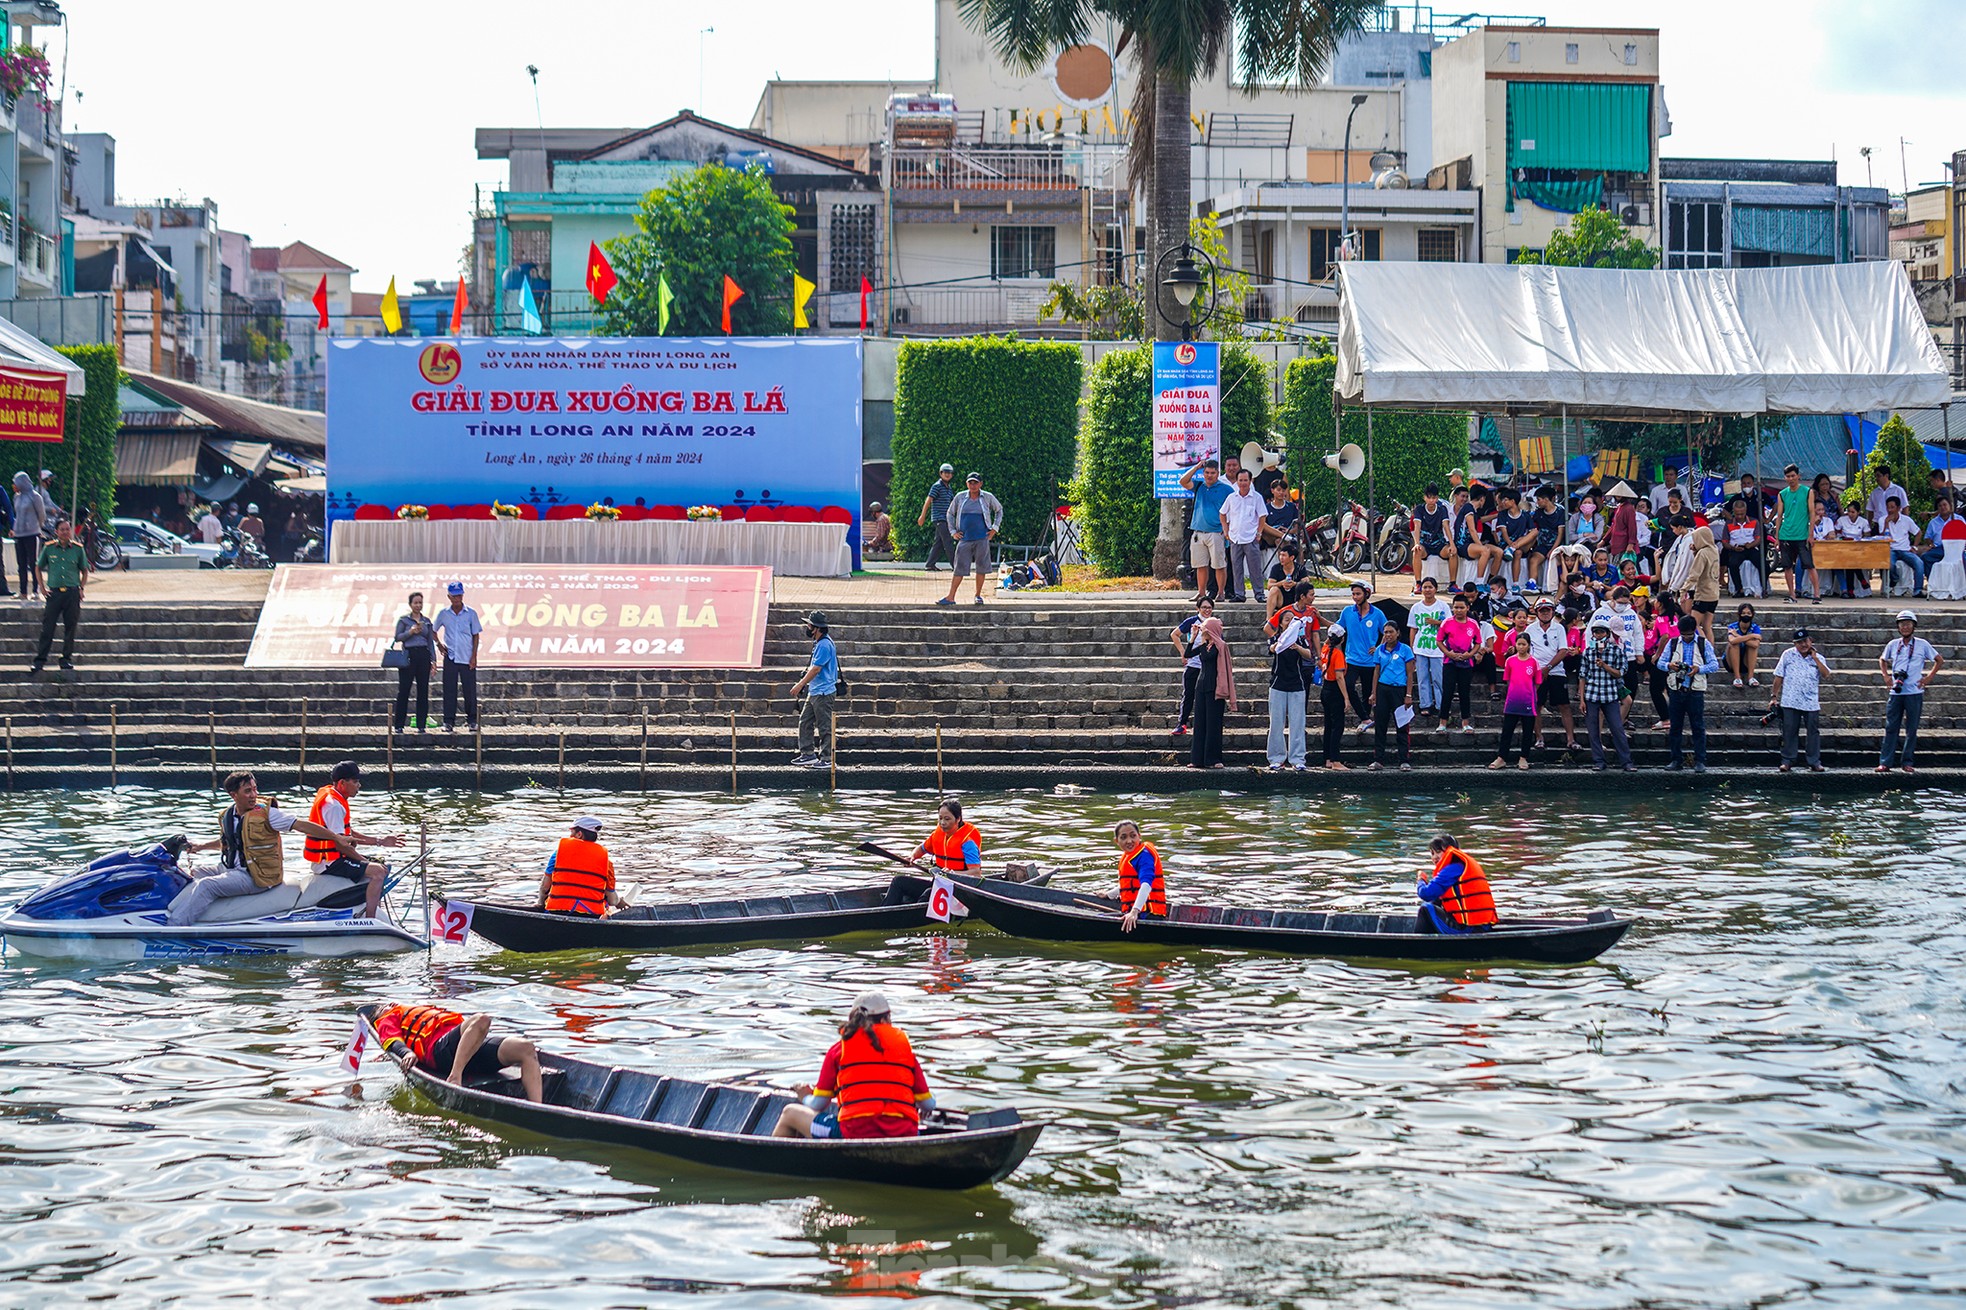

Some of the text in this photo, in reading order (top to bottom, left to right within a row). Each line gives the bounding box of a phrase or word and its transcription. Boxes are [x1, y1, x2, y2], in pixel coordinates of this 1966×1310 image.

[487, 350, 506, 359] ỦY
[511, 351, 541, 359] BAN
[545, 350, 587, 359] NHÂN
[592, 350, 622, 359] DÂN
[628, 350, 661, 359] TỈNH
[480, 361, 499, 369] SỞ
[504, 361, 534, 369] VĂN
[578, 359, 607, 369] THỂ
[656, 361, 675, 369] VÀ
[704, 362, 737, 371] LỊCH
[411, 384, 788, 413] GIẢI ĐUA XUỒNG BA LÁ
[1161, 387, 1210, 399] GIẢI ĐUA
[1189, 403, 1200, 413] BA
[466, 421, 756, 437] TỈNH LONG AN NĂM 2024
[1159, 418, 1213, 429] TỈNH LONG AN
[1186, 434, 1204, 442] 2024
[485, 451, 517, 466] Long
[546, 453, 577, 467] ngày
[579, 452, 594, 464] 26
[597, 452, 633, 467] tháng
[635, 452, 643, 464] 4
[646, 453, 673, 464] năm
[676, 452, 703, 464] 2024
[391, 573, 425, 581] ỨNG
[475, 573, 508, 581] VĂN
[675, 576, 712, 584] LỊCH
[564, 581, 599, 589] NĂM
[478, 594, 609, 628] XUỒNG
[618, 604, 665, 628] BA
[676, 599, 720, 628] LÁ
[488, 637, 531, 654] AN
[540, 633, 606, 654] NĂM
[614, 638, 685, 655] 2024
[933, 887, 949, 917] 6
[446, 911, 467, 942] 2
